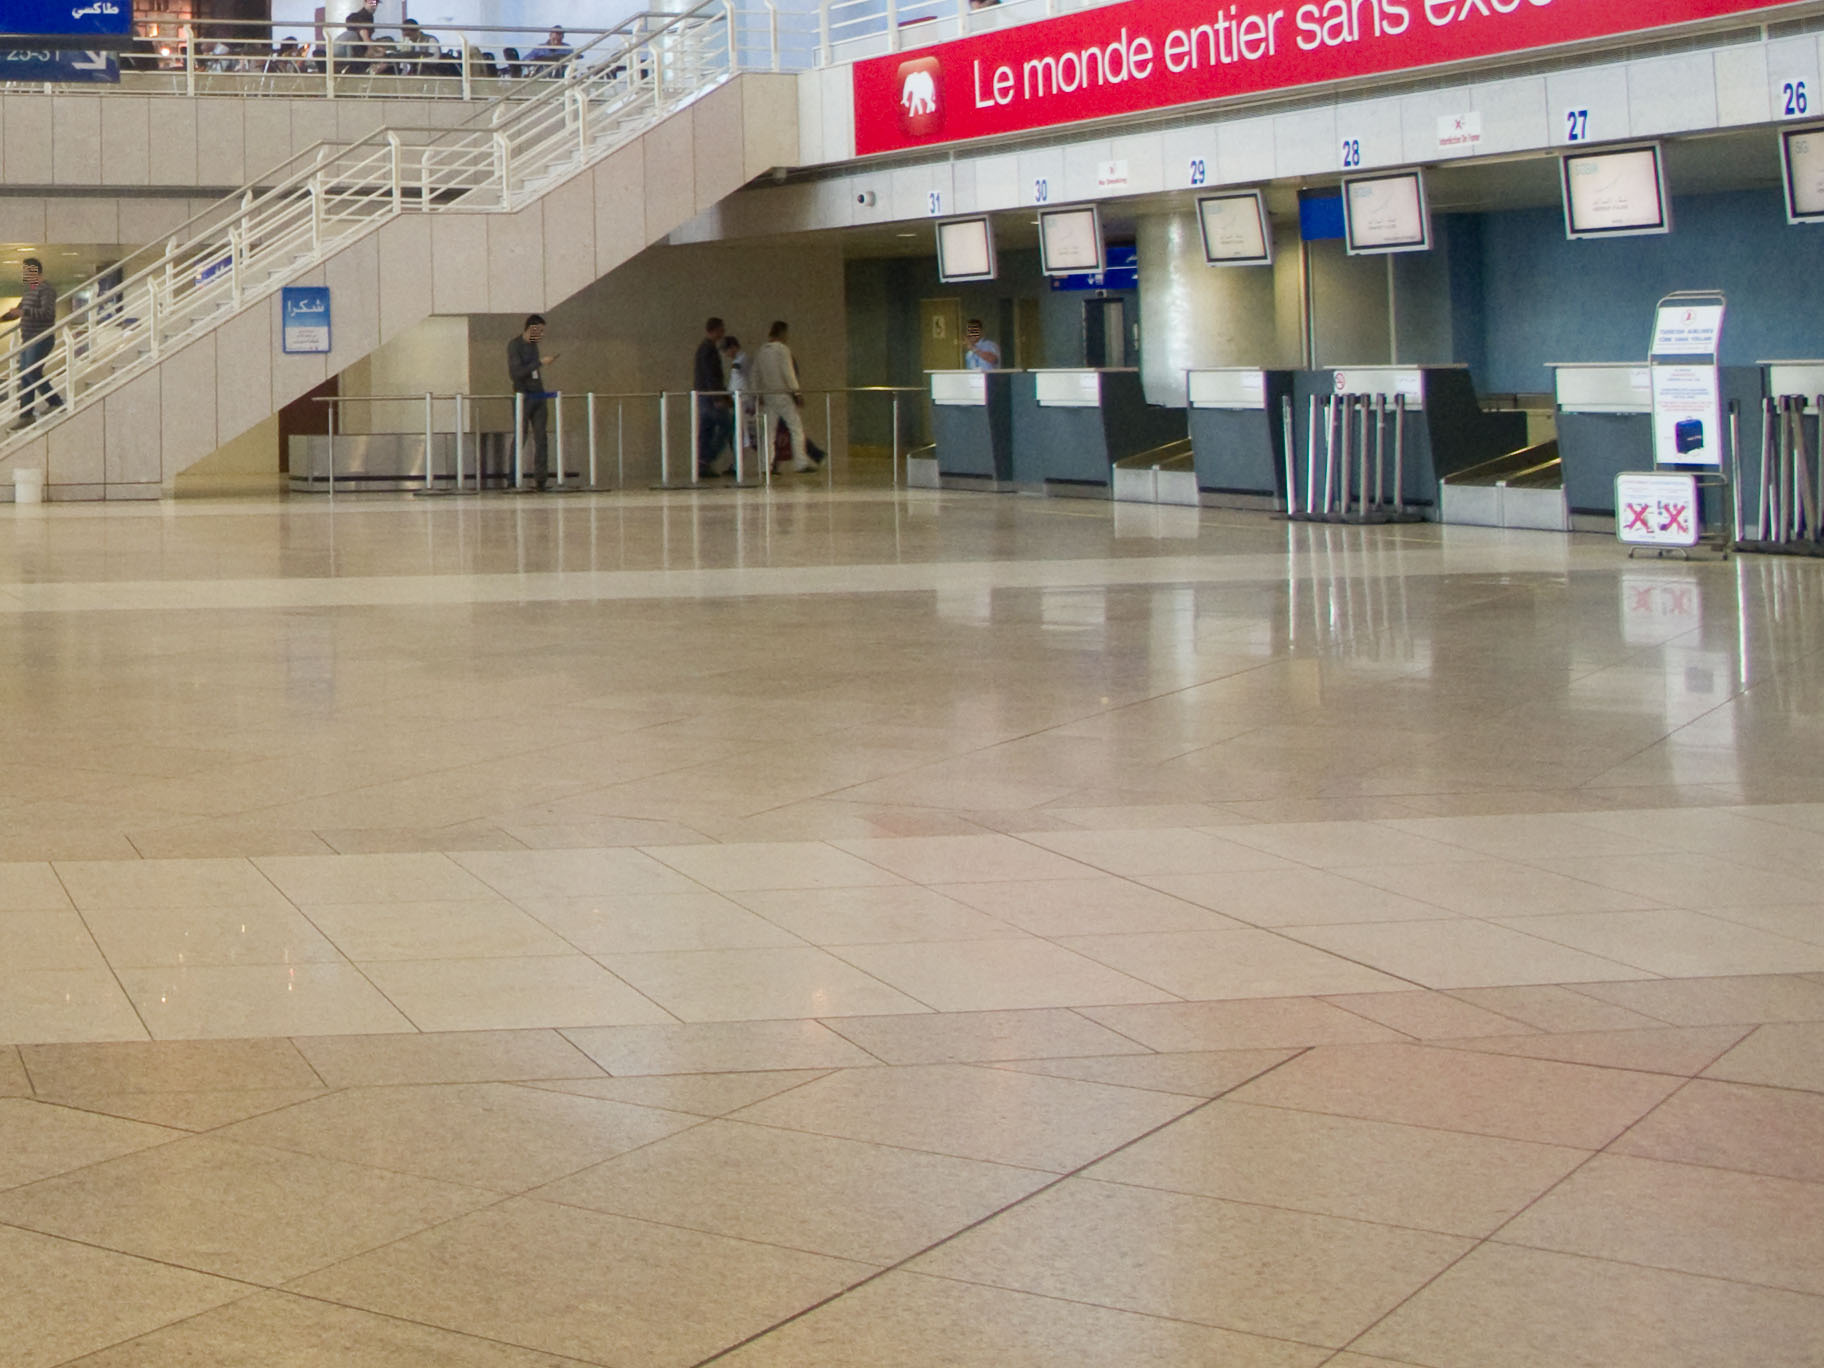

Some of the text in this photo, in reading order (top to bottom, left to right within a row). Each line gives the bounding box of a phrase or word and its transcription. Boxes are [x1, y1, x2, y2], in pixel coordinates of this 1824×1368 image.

[71, 2, 120, 19] طاكسي
[973, 59, 1014, 109] Le
[1023, 27, 1153, 101] monde
[1164, 4, 1285, 73] entier
[1783, 81, 1807, 115] 26
[1567, 108, 1589, 142] 27
[1342, 139, 1360, 167] 28
[1190, 159, 1206, 184] 29
[929, 192, 941, 213] 31
[1035, 179, 1048, 202] 30
[287, 299, 324, 317] شكرا
